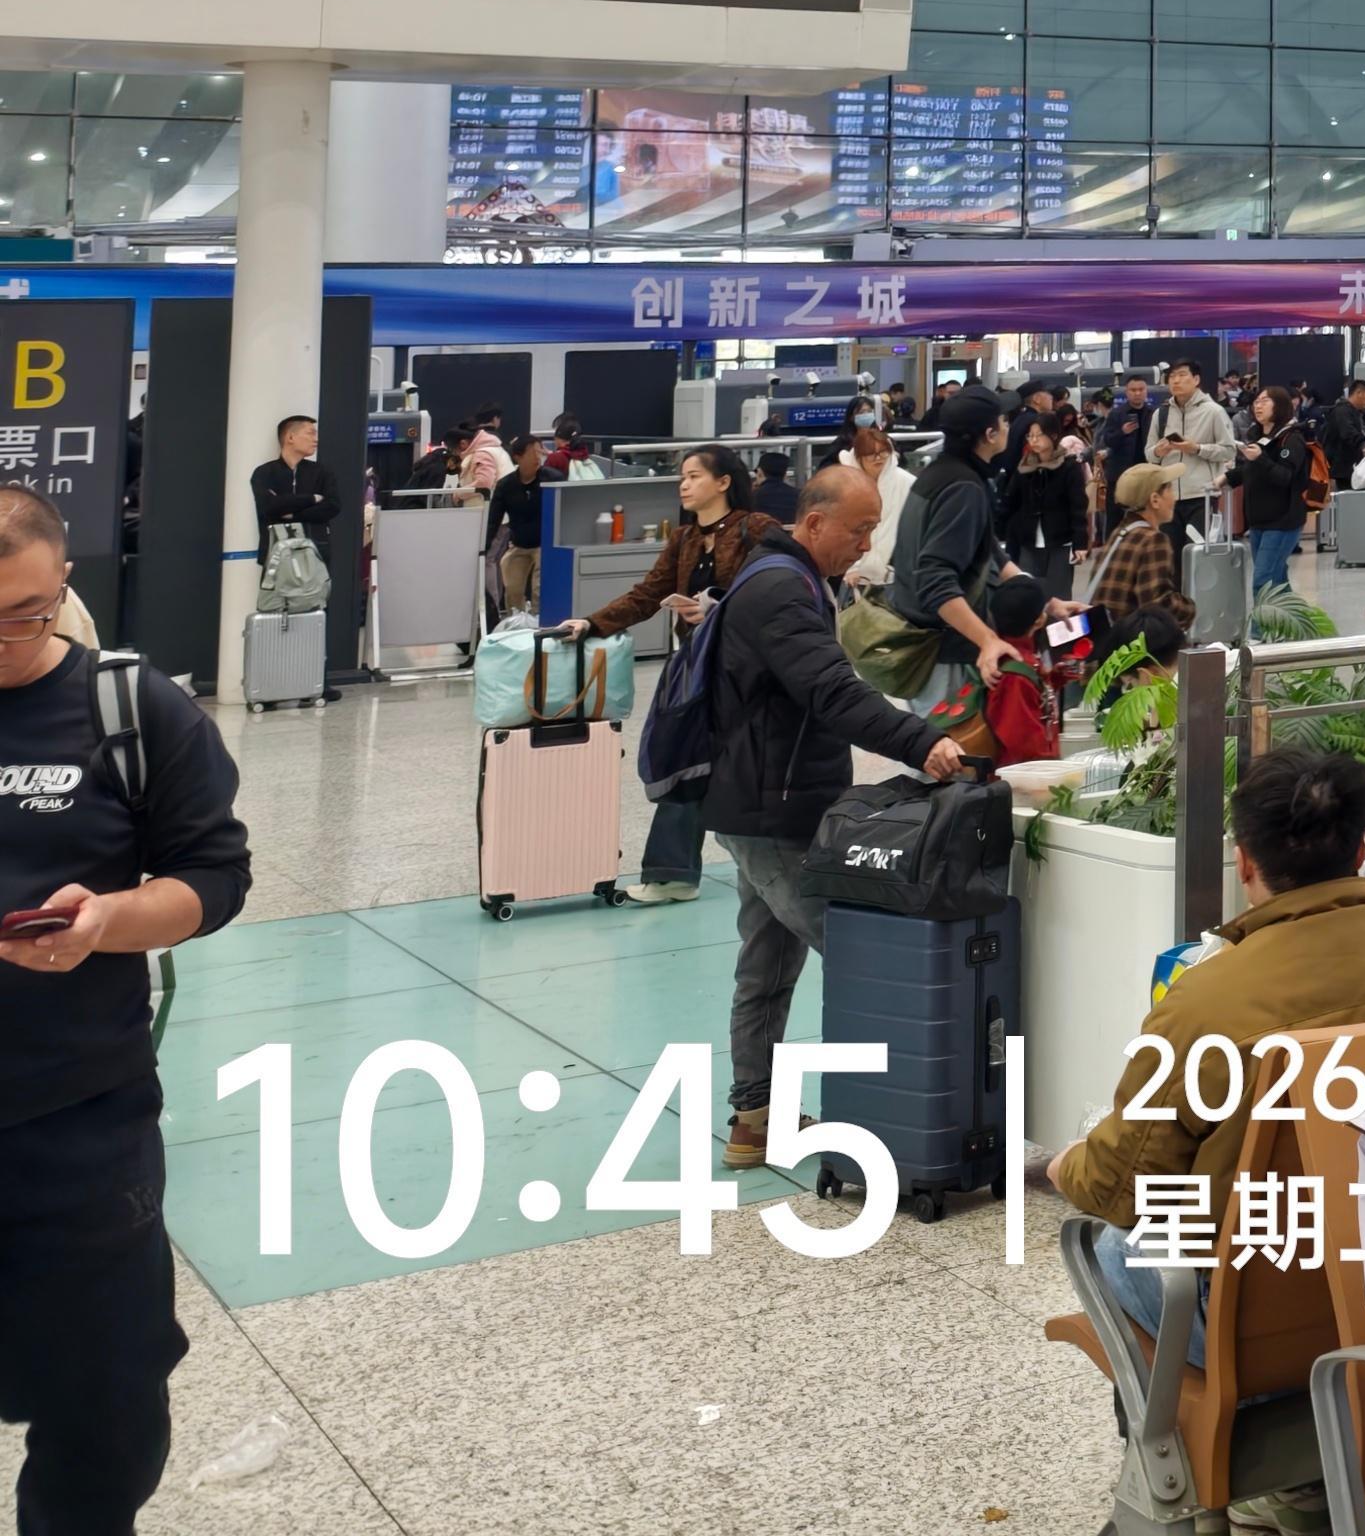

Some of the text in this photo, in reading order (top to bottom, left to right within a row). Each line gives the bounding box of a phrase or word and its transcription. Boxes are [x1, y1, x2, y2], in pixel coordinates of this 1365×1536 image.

[631, 276, 907, 329] 创新之城
[13, 340, 66, 409] B
[48, 473, 73, 494] in
[0, 765, 82, 795] OUND
[29, 798, 64, 810] PEAK
[845, 845, 903, 871] SPORT
